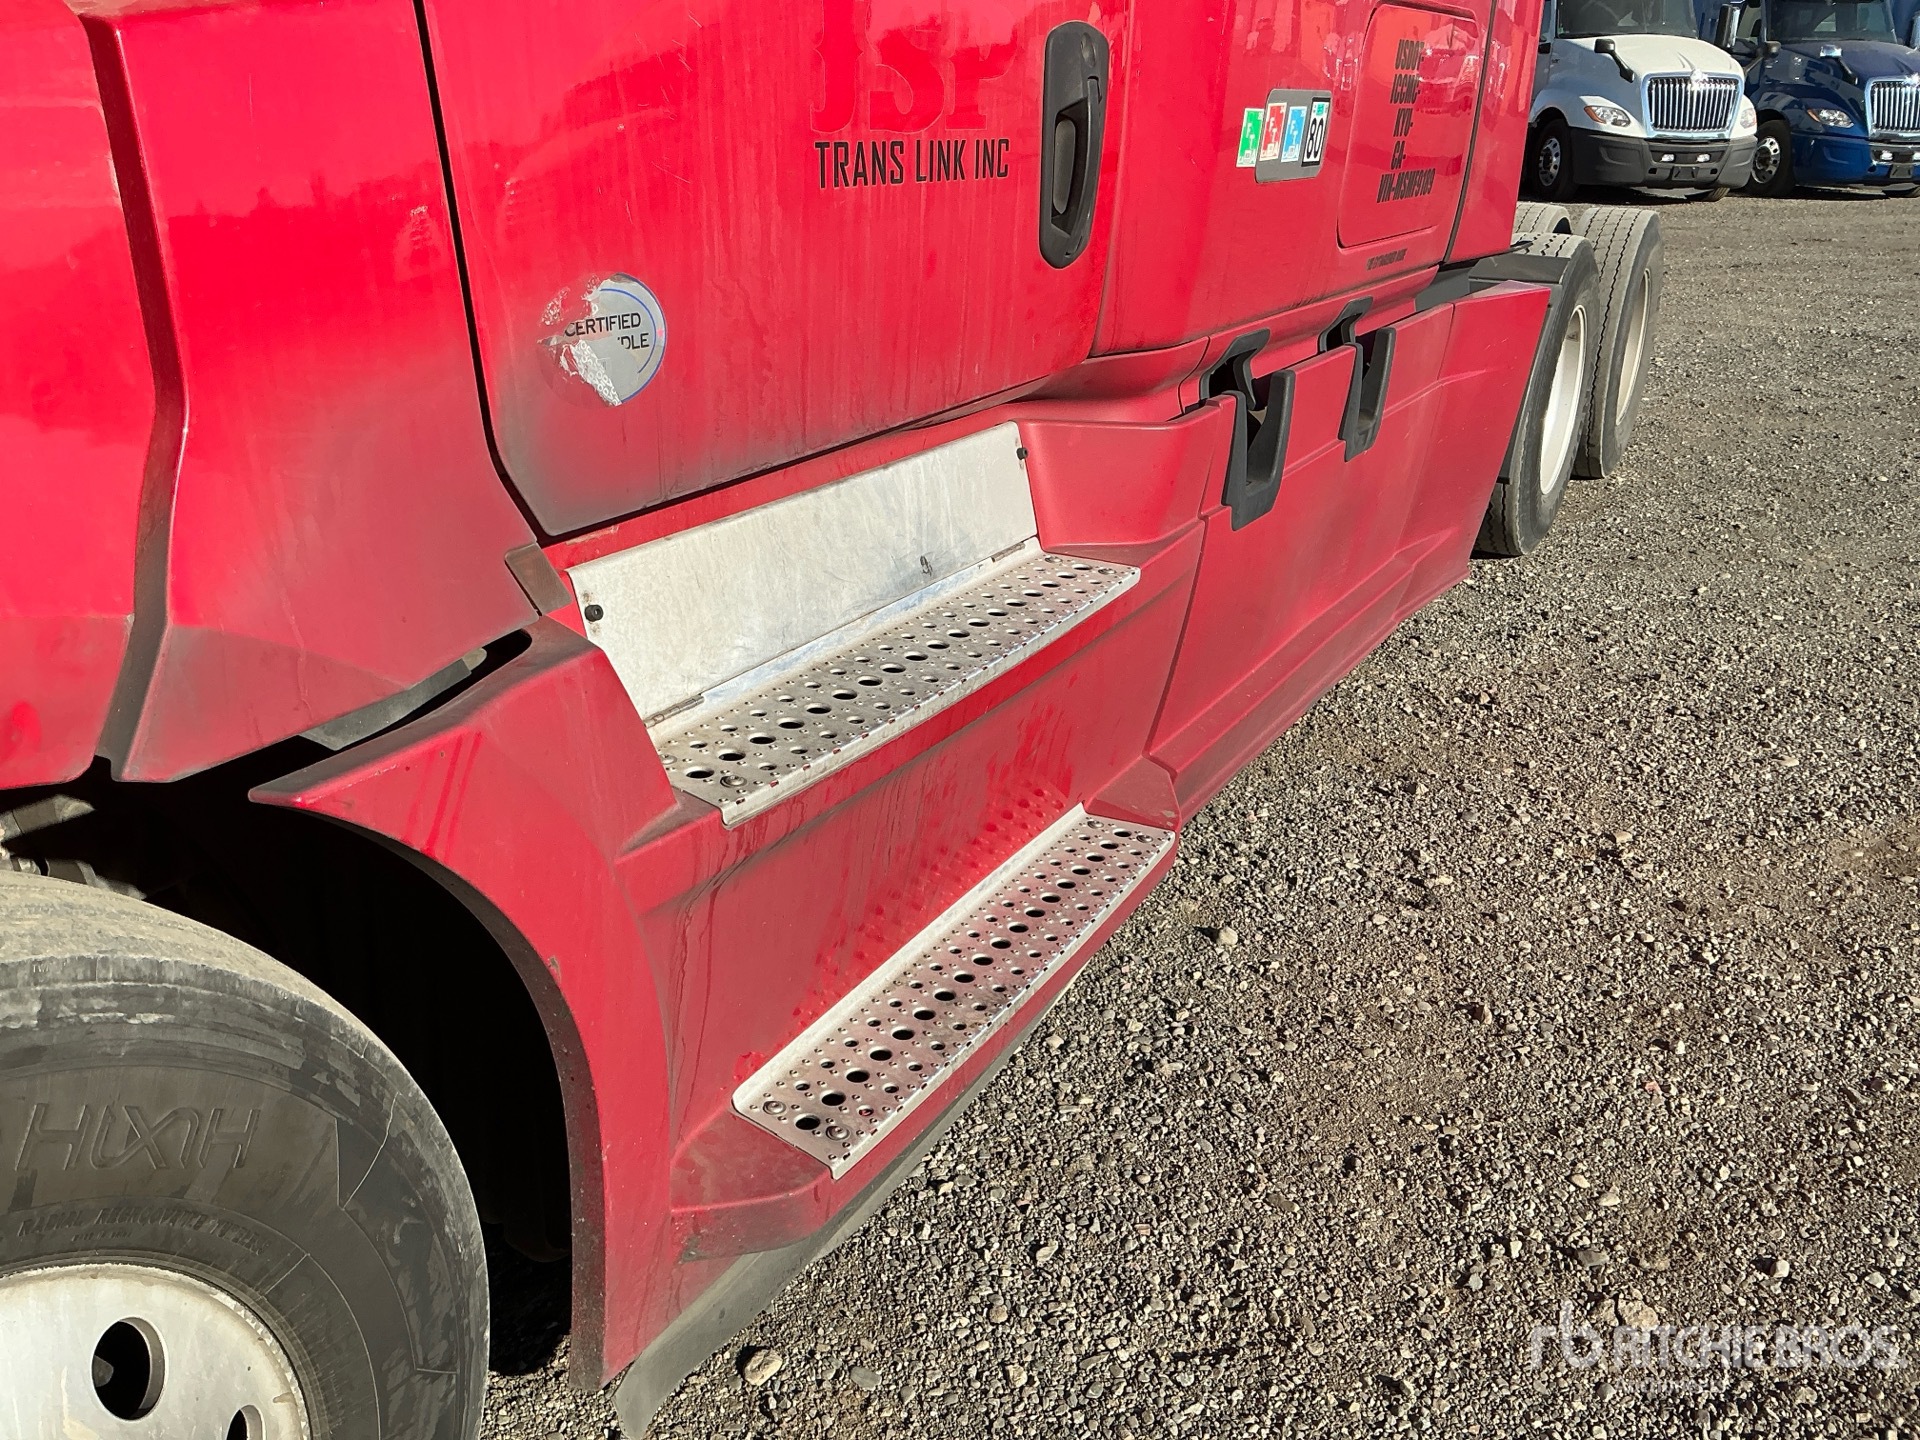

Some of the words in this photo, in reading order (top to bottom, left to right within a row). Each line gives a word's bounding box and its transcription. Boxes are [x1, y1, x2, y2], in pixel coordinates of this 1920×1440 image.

[1306, 117, 1324, 159] 80
[815, 141, 905, 189] TRANS
[915, 139, 966, 182] LINK
[974, 138, 1010, 180] INC
[564, 312, 642, 337] CERTIFIED
[617, 332, 650, 350] DLE
